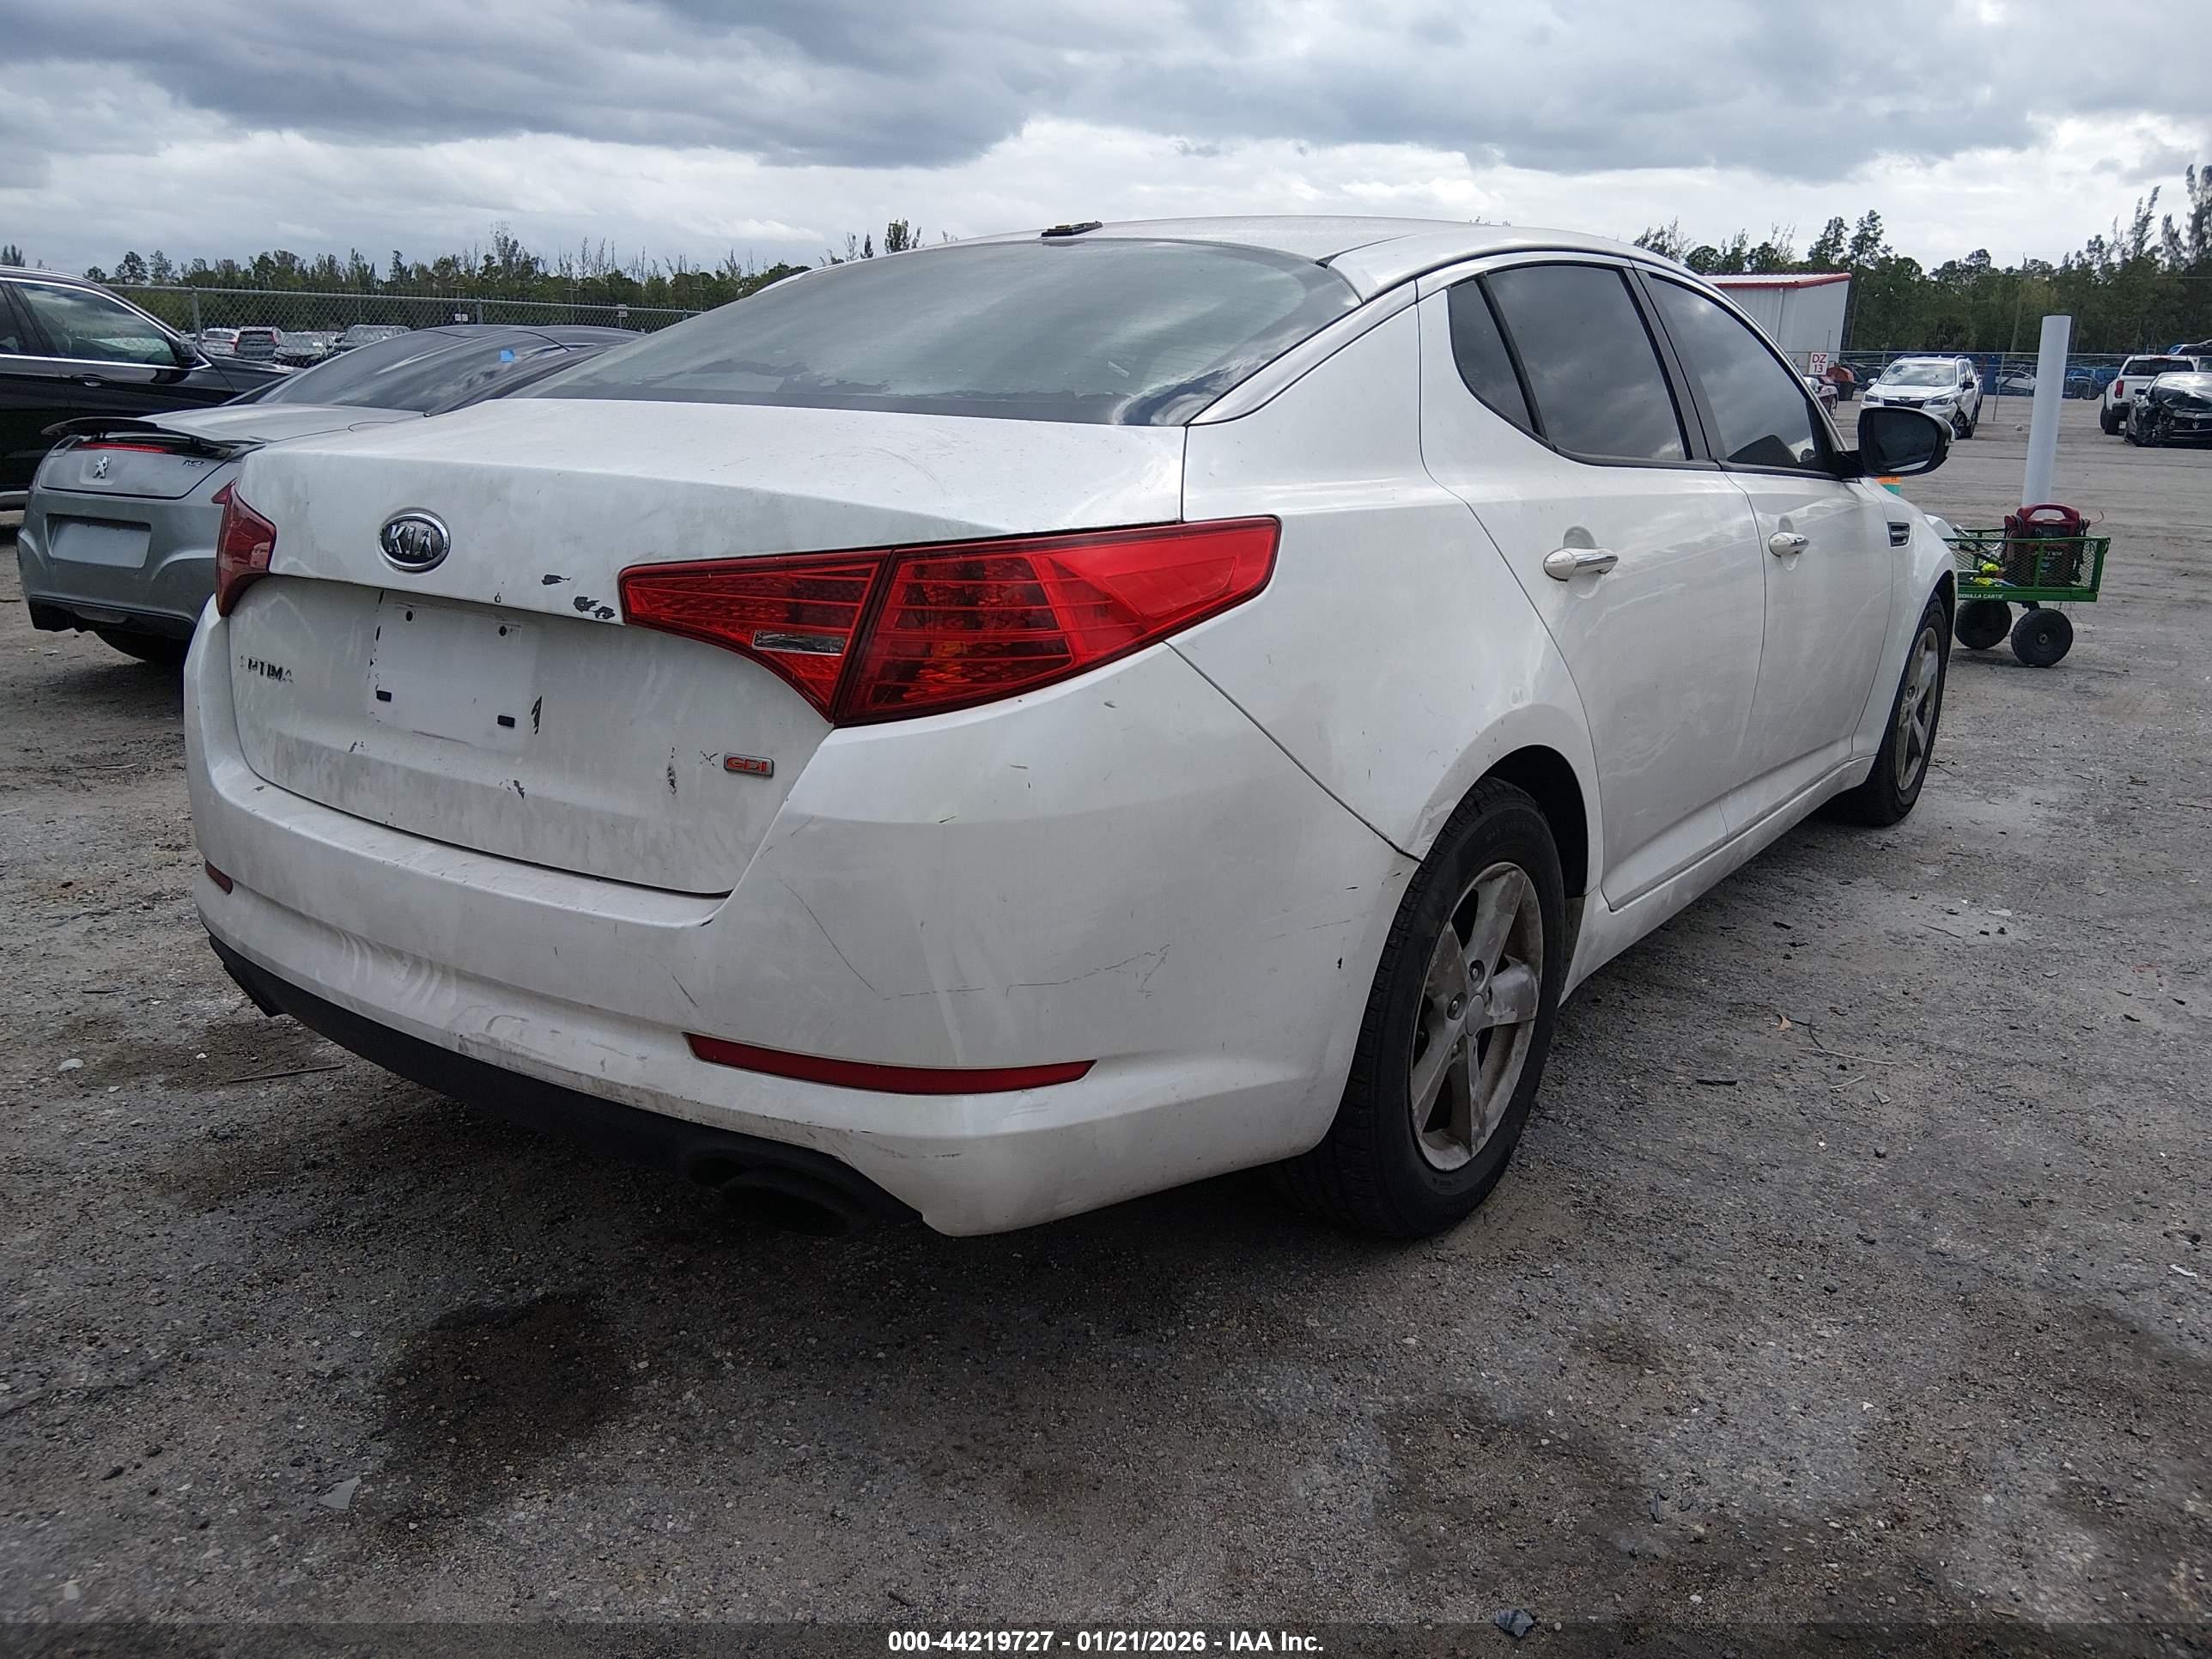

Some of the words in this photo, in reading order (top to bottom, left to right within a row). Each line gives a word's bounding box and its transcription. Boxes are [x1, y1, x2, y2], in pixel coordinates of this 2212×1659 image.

[1812, 354, 1827, 364] DZ
[1814, 364, 1824, 374] 13
[388, 525, 434, 558] KIA
[726, 757, 768, 773] GDI
